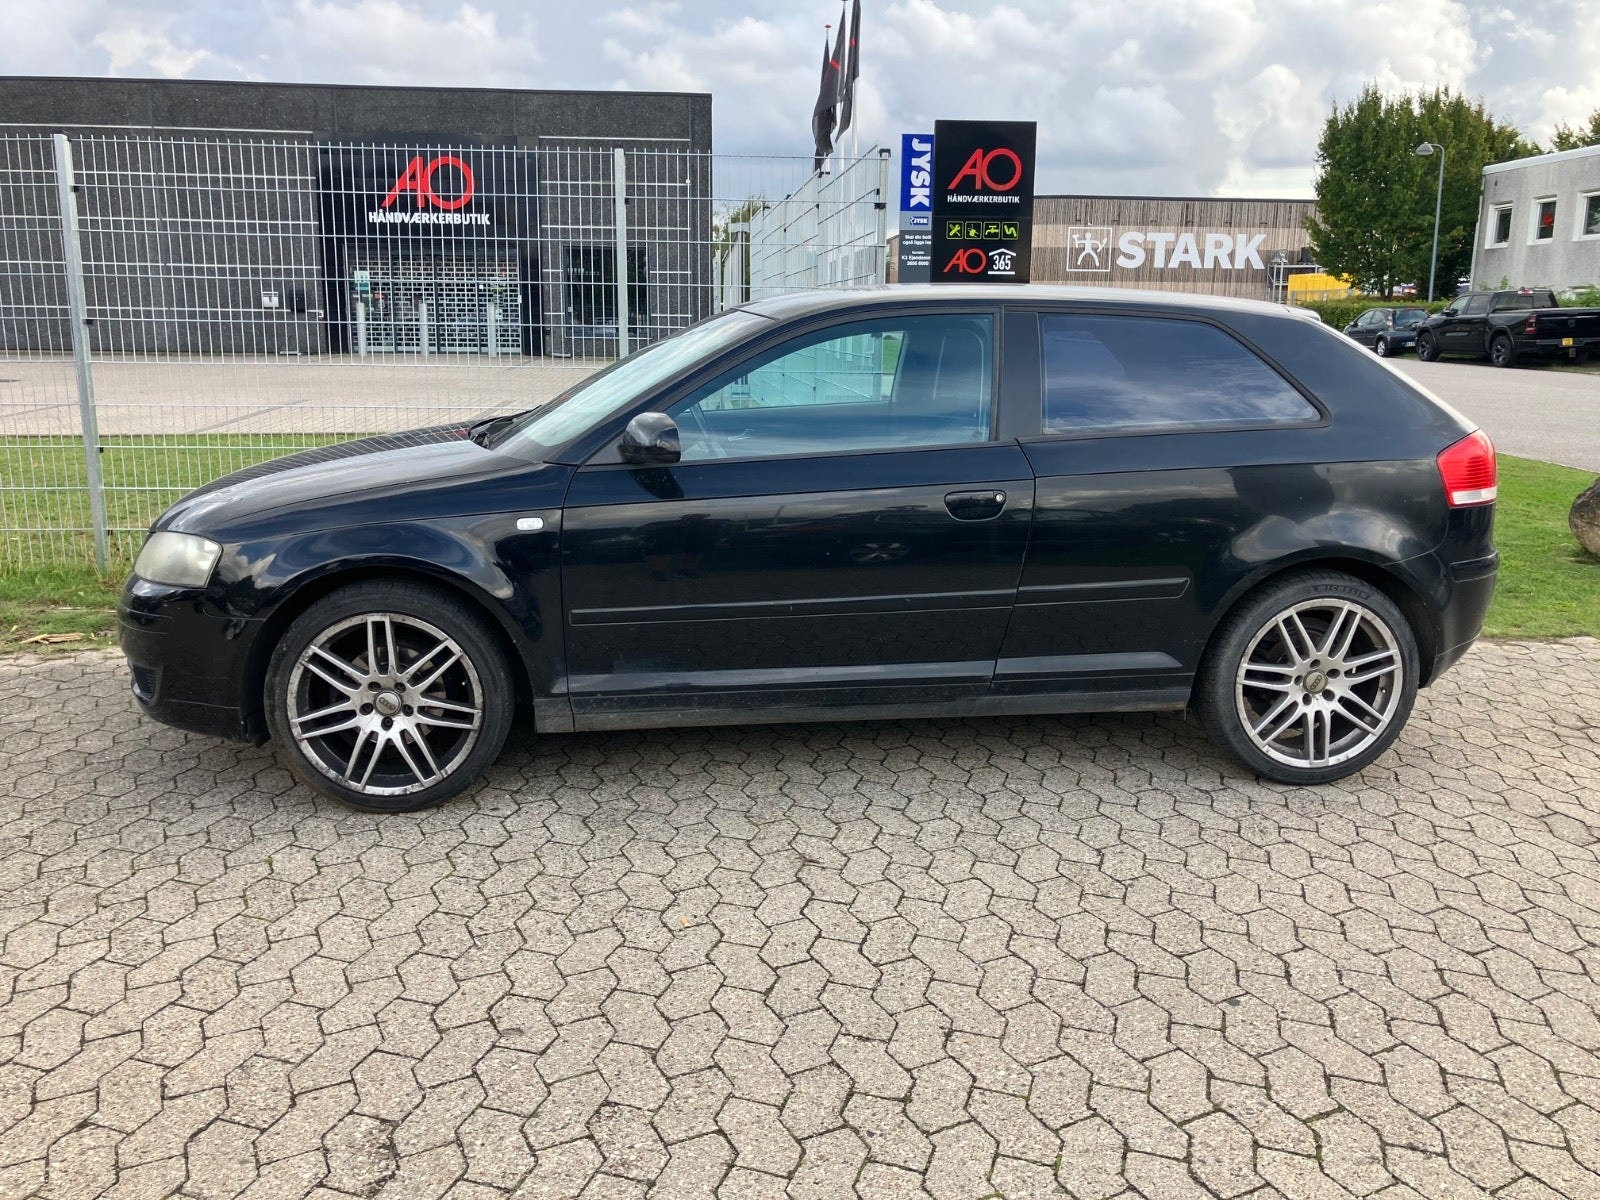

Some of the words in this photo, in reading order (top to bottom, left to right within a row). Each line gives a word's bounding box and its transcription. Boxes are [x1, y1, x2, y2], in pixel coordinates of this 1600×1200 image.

[381, 155, 476, 209] AO
[911, 138, 931, 207] JYSK
[947, 148, 1022, 192] AO
[368, 209, 491, 225] HÅNDVÆRKERBUTIK
[947, 193, 1020, 204] HÅNDVÆRKERBUTIK
[944, 248, 987, 274] AO
[993, 255, 1011, 271] 365
[1115, 231, 1267, 270] STARK
